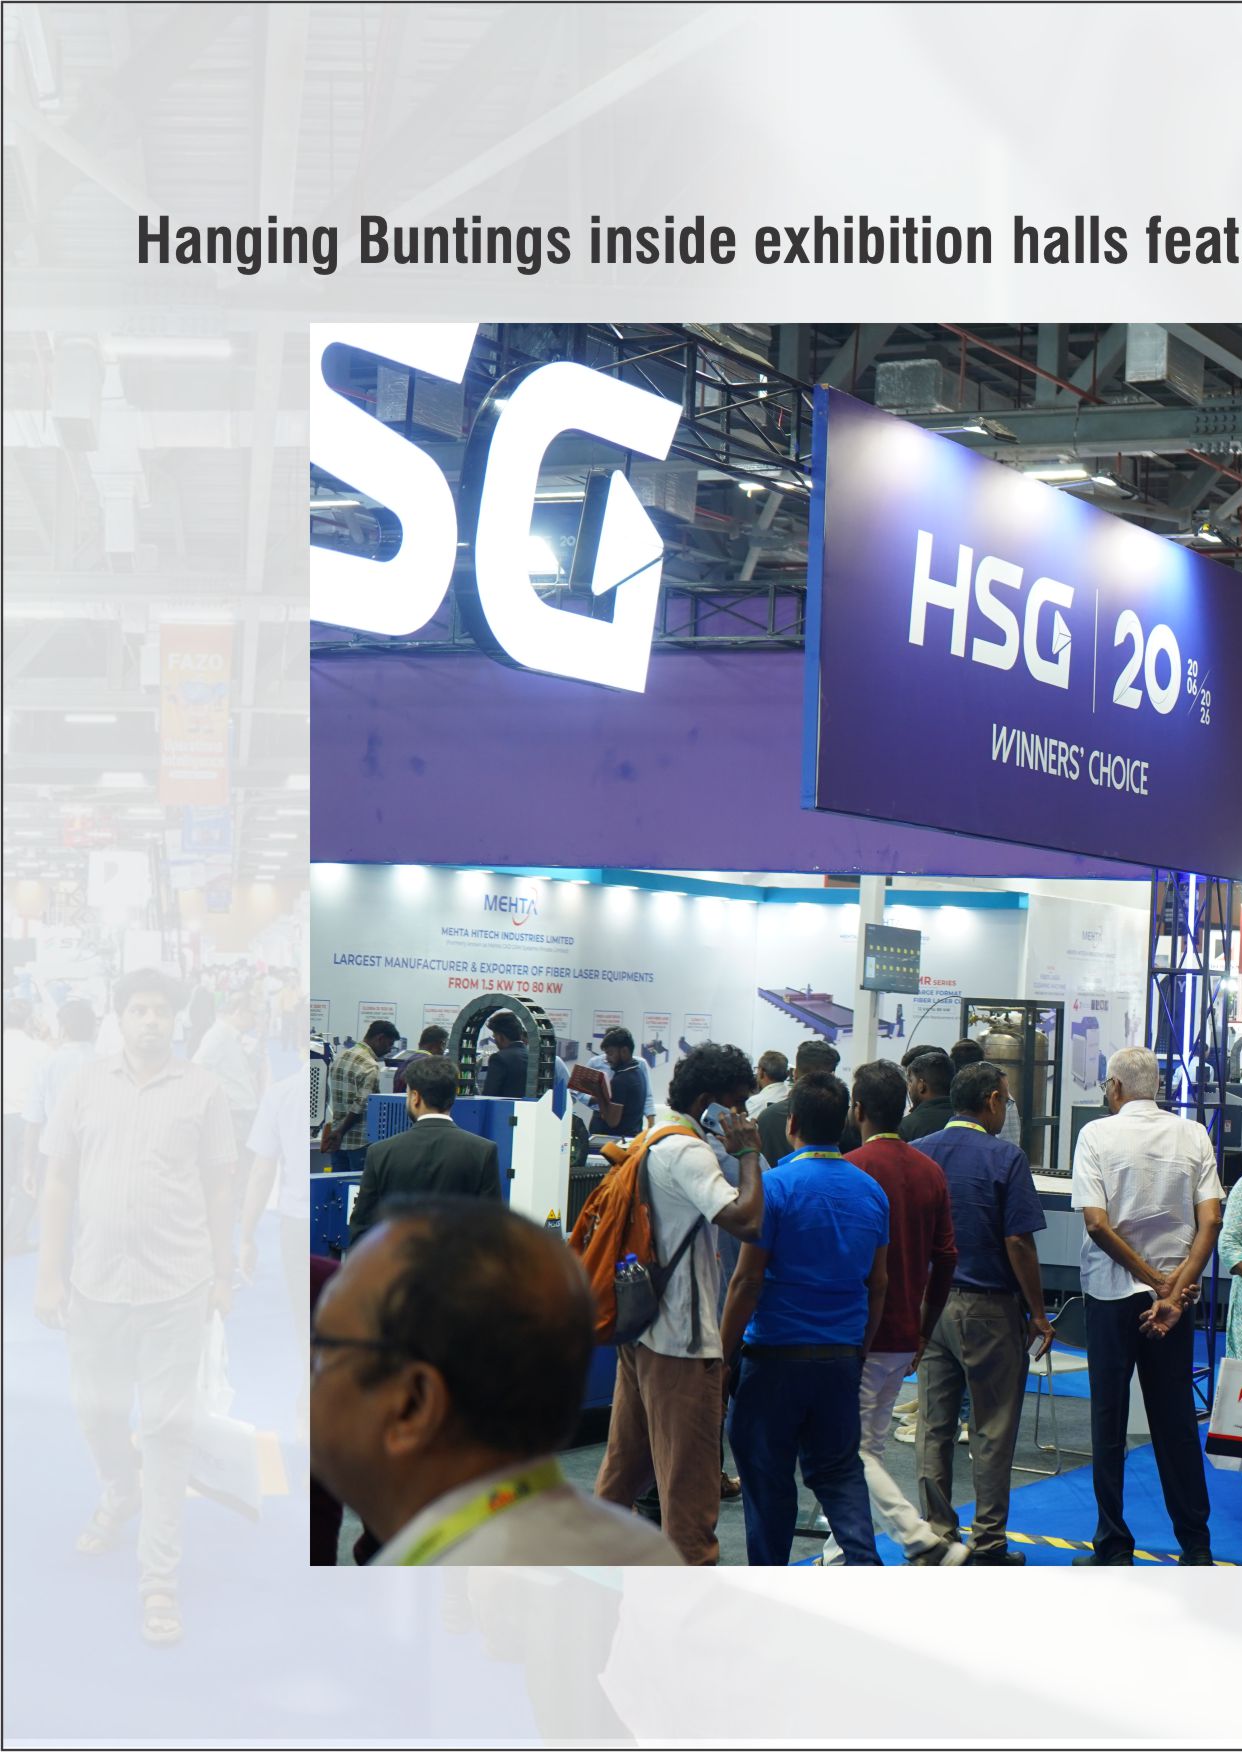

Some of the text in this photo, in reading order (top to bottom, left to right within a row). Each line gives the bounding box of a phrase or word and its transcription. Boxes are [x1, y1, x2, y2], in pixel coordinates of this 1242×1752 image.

[908, 529, 1181, 715] HSG 20
[168, 654, 224, 672] FAZO
[1187, 658, 1198, 678] 20
[1186, 678, 1197, 696] 06
[1201, 688, 1211, 708] 20
[1200, 707, 1210, 726] 26
[1088, 750, 1148, 796] CHOICE
[483, 894, 538, 915] MEHTA
[441, 926, 574, 946] MEHTA HITECH INDUSTRIES LIMITED
[333, 952, 654, 983] LARGEST MANUFACTURER & EXPORTER OF FIBER LASER EQUIPMENTS
[448, 978, 563, 994] FROM 1.5 KW TO 80 KW
